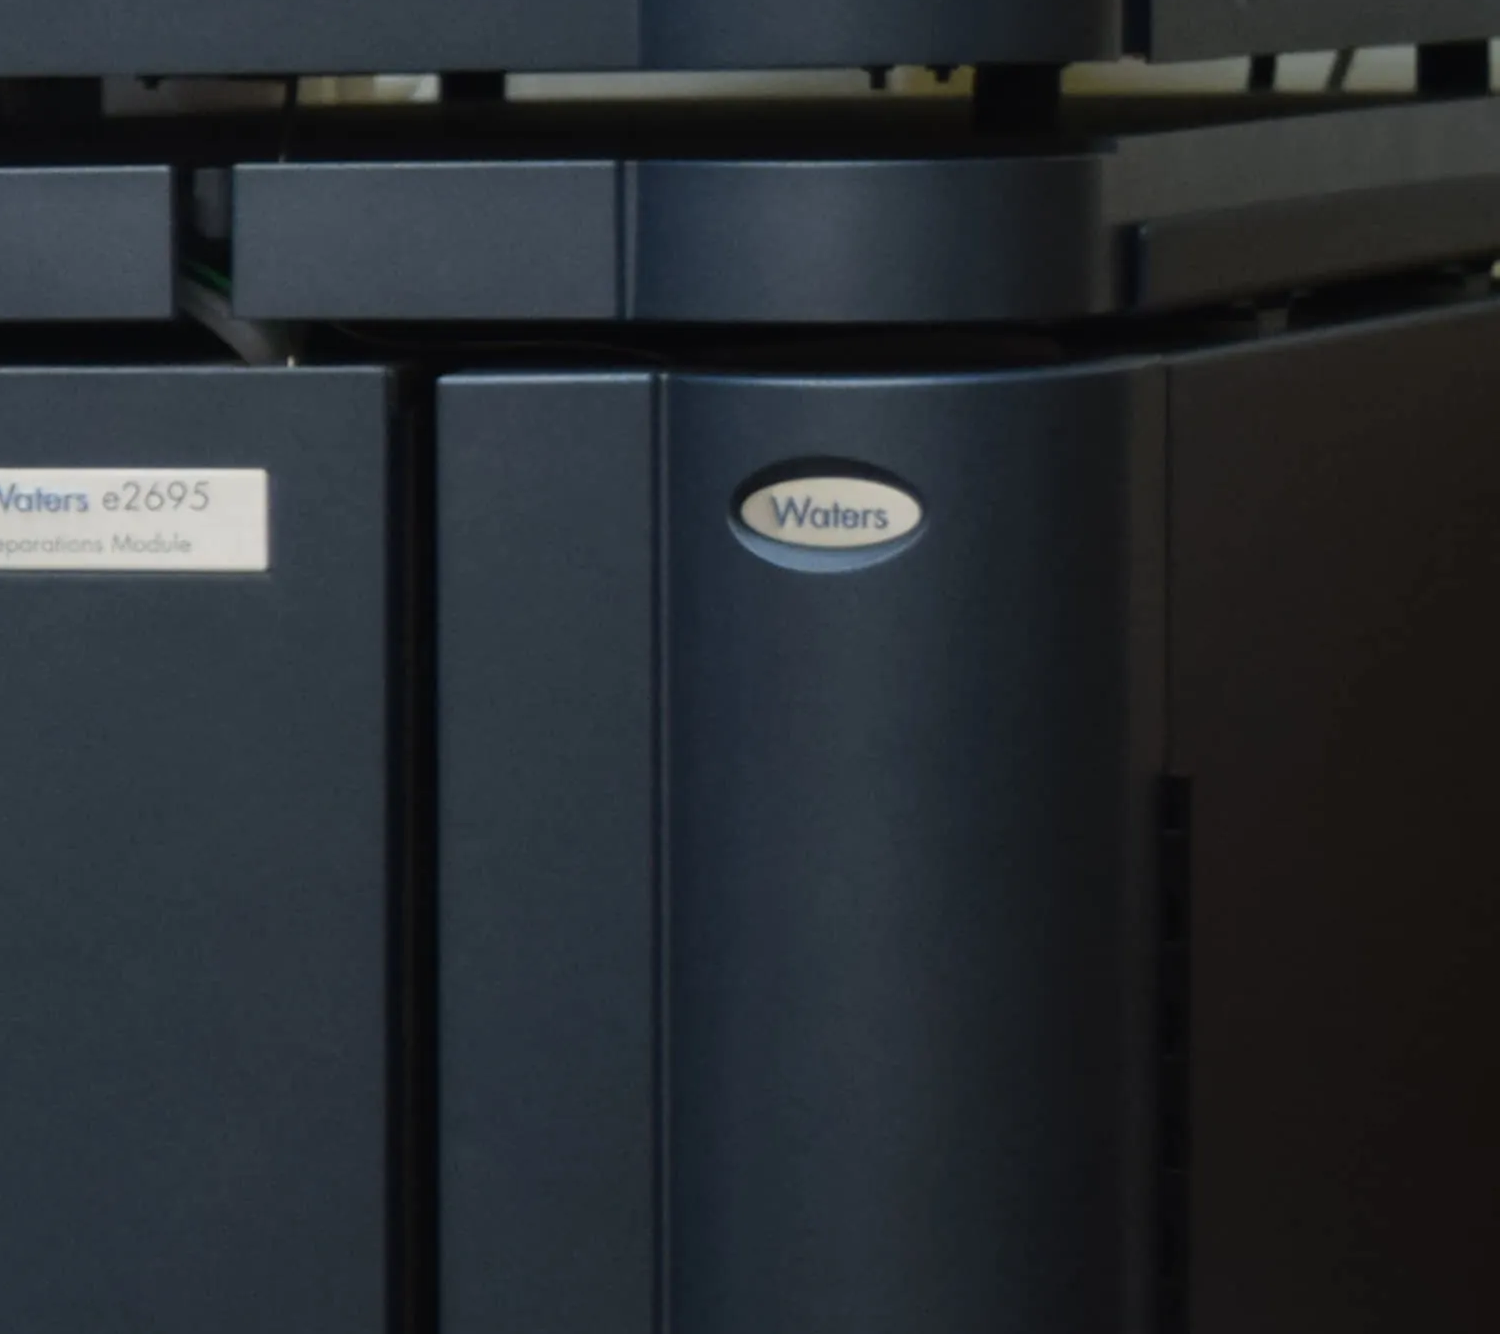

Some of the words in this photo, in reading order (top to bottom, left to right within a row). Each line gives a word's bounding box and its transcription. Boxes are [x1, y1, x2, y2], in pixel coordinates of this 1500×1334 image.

[101, 480, 211, 512] e2695
[771, 495, 890, 529] Waters
[111, 532, 193, 554] Module
